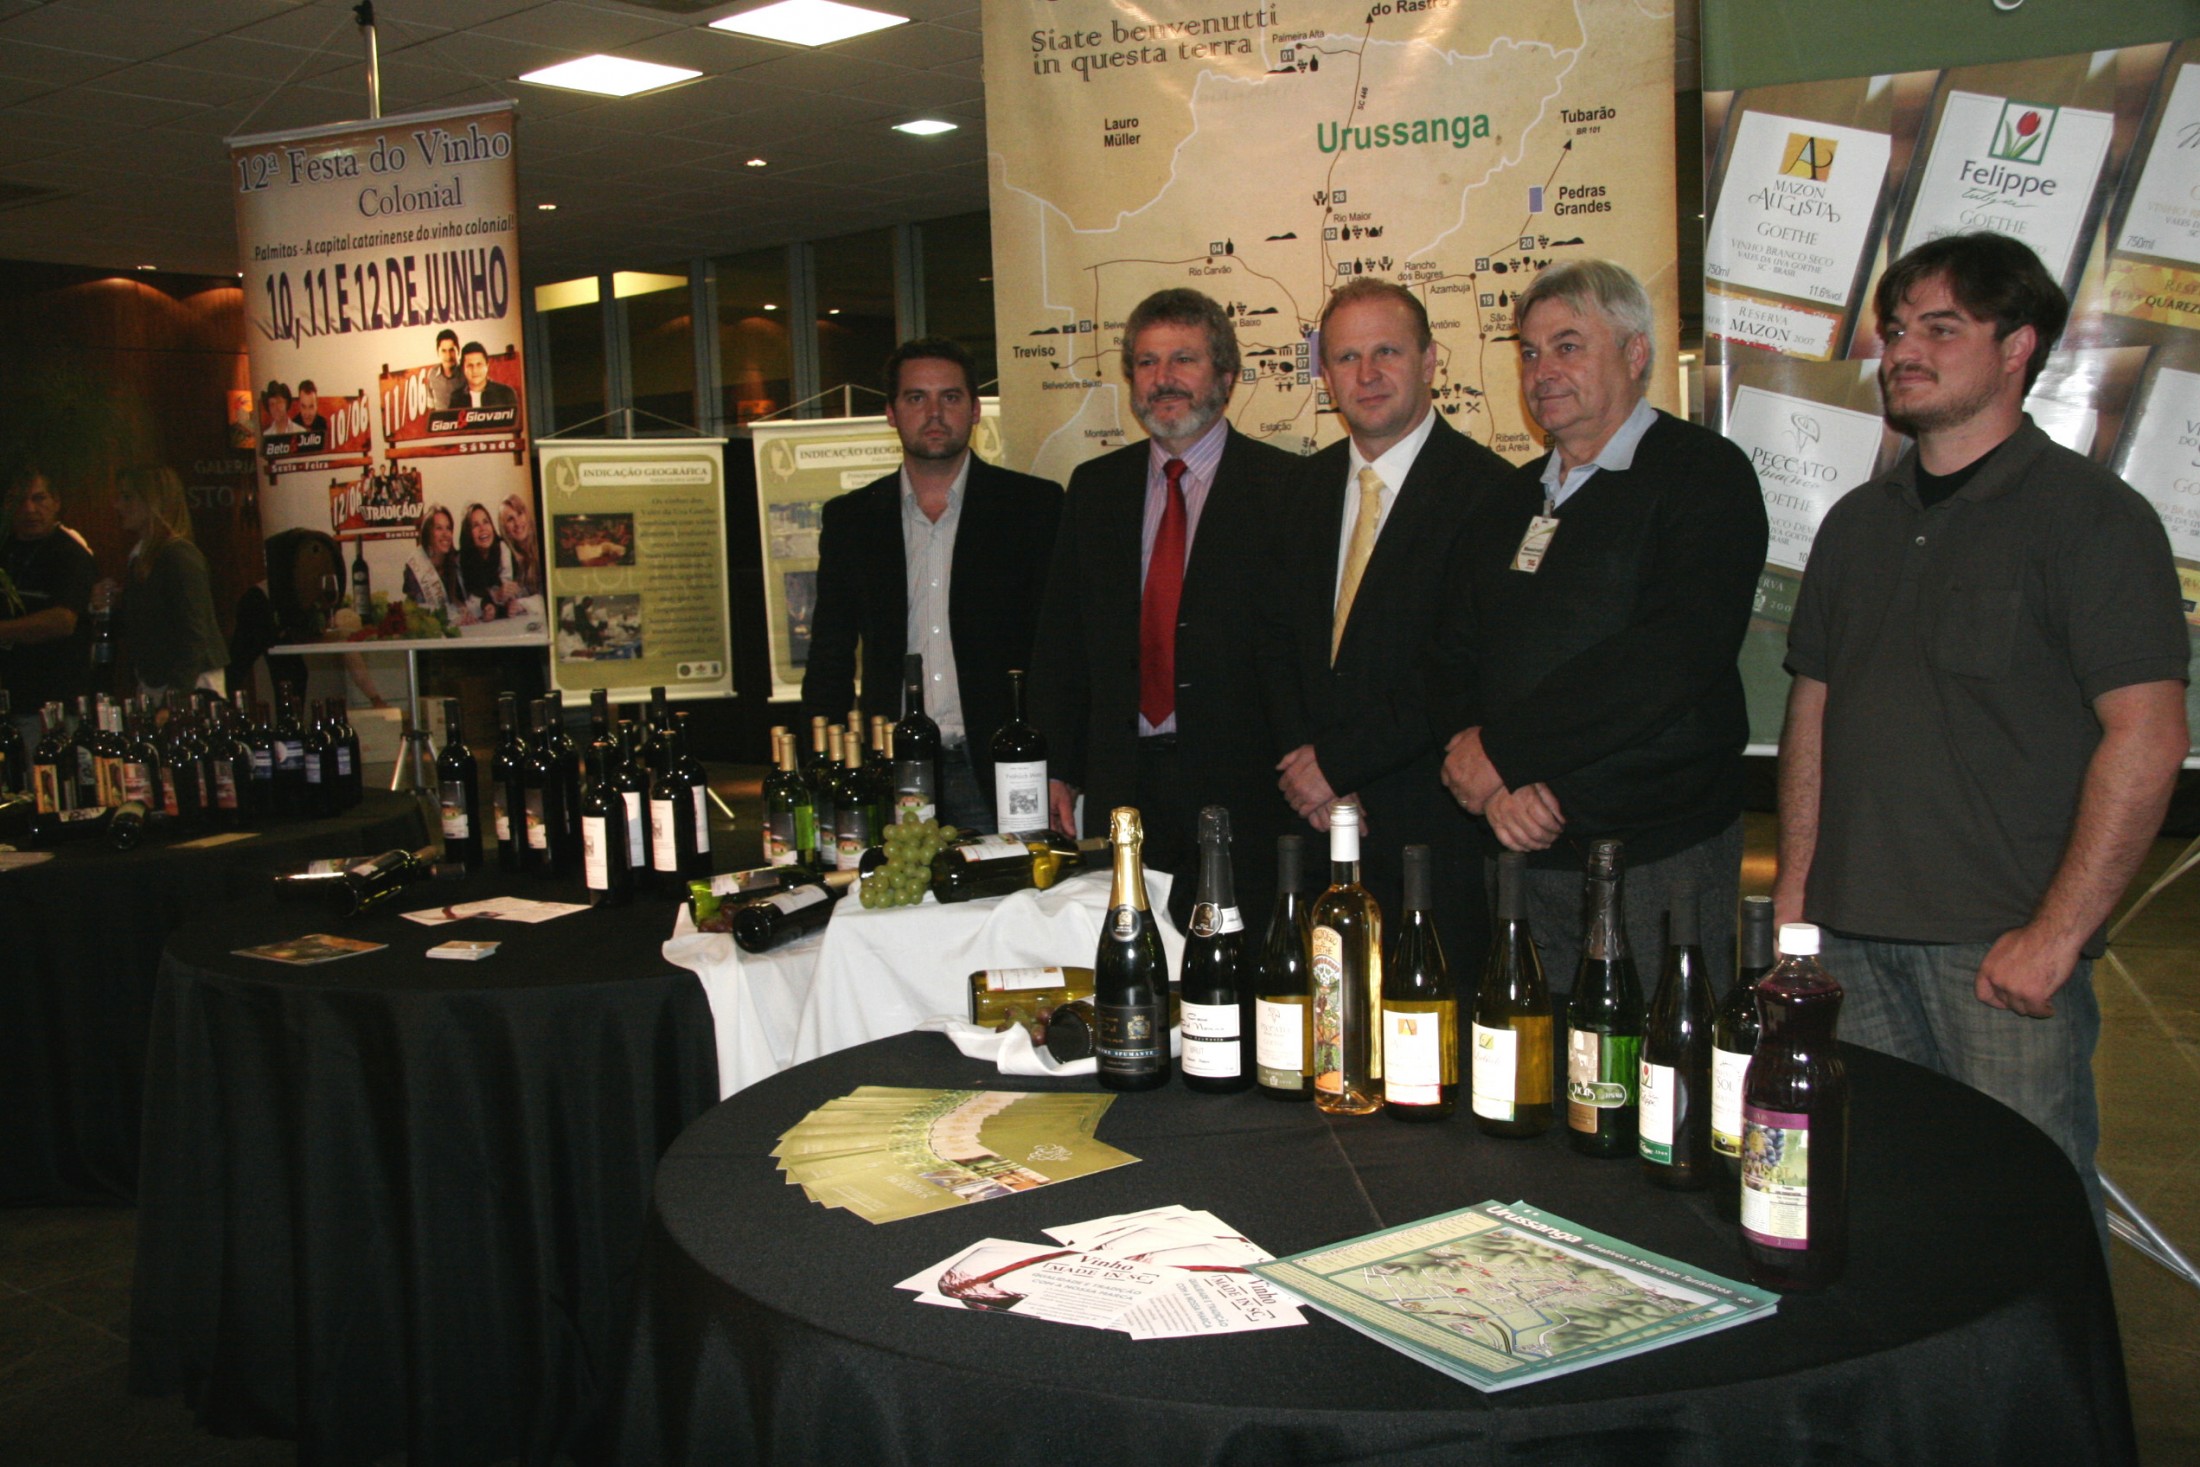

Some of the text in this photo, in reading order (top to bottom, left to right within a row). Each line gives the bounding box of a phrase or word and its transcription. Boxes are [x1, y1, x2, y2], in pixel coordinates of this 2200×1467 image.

[1371, 3, 1392, 16] do
[1031, 3, 1279, 52] Siate benvenutti
[1272, 28, 1325, 43] Palmeira Alta
[1033, 36, 1253, 82] in questa terra
[1104, 117, 1140, 131] Lauro
[1561, 106, 1616, 124] Tubarão
[1103, 133, 1141, 147] Müller
[1317, 113, 1491, 153] Urussanga
[1576, 126, 1601, 136] BR 101
[240, 124, 511, 192] 12ª Festa do Vinho
[1960, 159, 2057, 198] Felippe
[359, 177, 462, 217] Colonial
[1559, 185, 1606, 200] Pedras
[1773, 180, 1826, 199] MAZON
[1554, 199, 1611, 217] Grandes
[1748, 187, 1841, 223] AUGUSTA
[1334, 213, 1347, 222] Rio
[1960, 209, 2029, 234] GOETHE
[255, 214, 515, 261] Palmitos A capital catarinense do vinho colonial!
[1757, 221, 1820, 246] GOETHE
[2127, 235, 2155, 250] 750ml
[1730, 239, 1834, 267] VINHO BRANCO SECO
[1189, 265, 1232, 276] Rio Carvão
[1405, 260, 1436, 272] Rancho
[1707, 262, 1730, 277] 750ml
[1398, 270, 1444, 282] dos Bugres
[304, 268, 331, 335] 11
[336, 263, 351, 332] E
[355, 262, 384, 331] 12
[386, 256, 421, 326] DE
[423, 246, 510, 325] JUNHO
[1430, 283, 1471, 295] Azambuja
[1240, 318, 1261, 328] Baixo
[1430, 319, 1460, 330] Antônio
[1739, 306, 1788, 326] RESERVA
[1483, 324, 1494, 333] de
[1729, 319, 1791, 342] MAZON
[1013, 345, 1055, 358] Treviso
[1042, 381, 1079, 391] Belvedere
[384, 368, 427, 437] 11/06
[330, 395, 368, 450] 10/06
[431, 420, 458, 431] Gian
[465, 408, 514, 422] Giovani
[1260, 422, 1291, 433] Estação
[266, 443, 290, 456] Beto
[298, 433, 322, 446] Julio
[459, 440, 516, 453] Sábado
[1495, 432, 1530, 443] Ribeirão
[800, 448, 863, 459] INDICAÇÃO
[1496, 443, 1530, 453] da Areia
[305, 461, 329, 471] Feira
[583, 467, 708, 479] INDICAÇÃO GEOGRÁFICA
[1751, 446, 1837, 483] PECCATO
[333, 481, 362, 528] 12/06
[1764, 489, 1813, 512] OETHE
[1486, 1205, 1583, 1244] Urussanga
[1080, 1255, 1134, 1271] Vinho
[1637, 1259, 1680, 1279] Serviços
[1052, 1264, 1151, 1283] MADE IN SC
[1032, 1273, 1083, 1284] QUALIDADE
[1093, 1283, 1142, 1296] TRADIÇÃO
[1032, 1278, 1054, 1287] COM
[1065, 1284, 1096, 1295] NOSSA
[1098, 1290, 1134, 1301] MARCA
[1211, 1278, 1242, 1297] MADE
[1236, 1298, 1250, 1307] IN
[1249, 1279, 1278, 1305] Vinho
